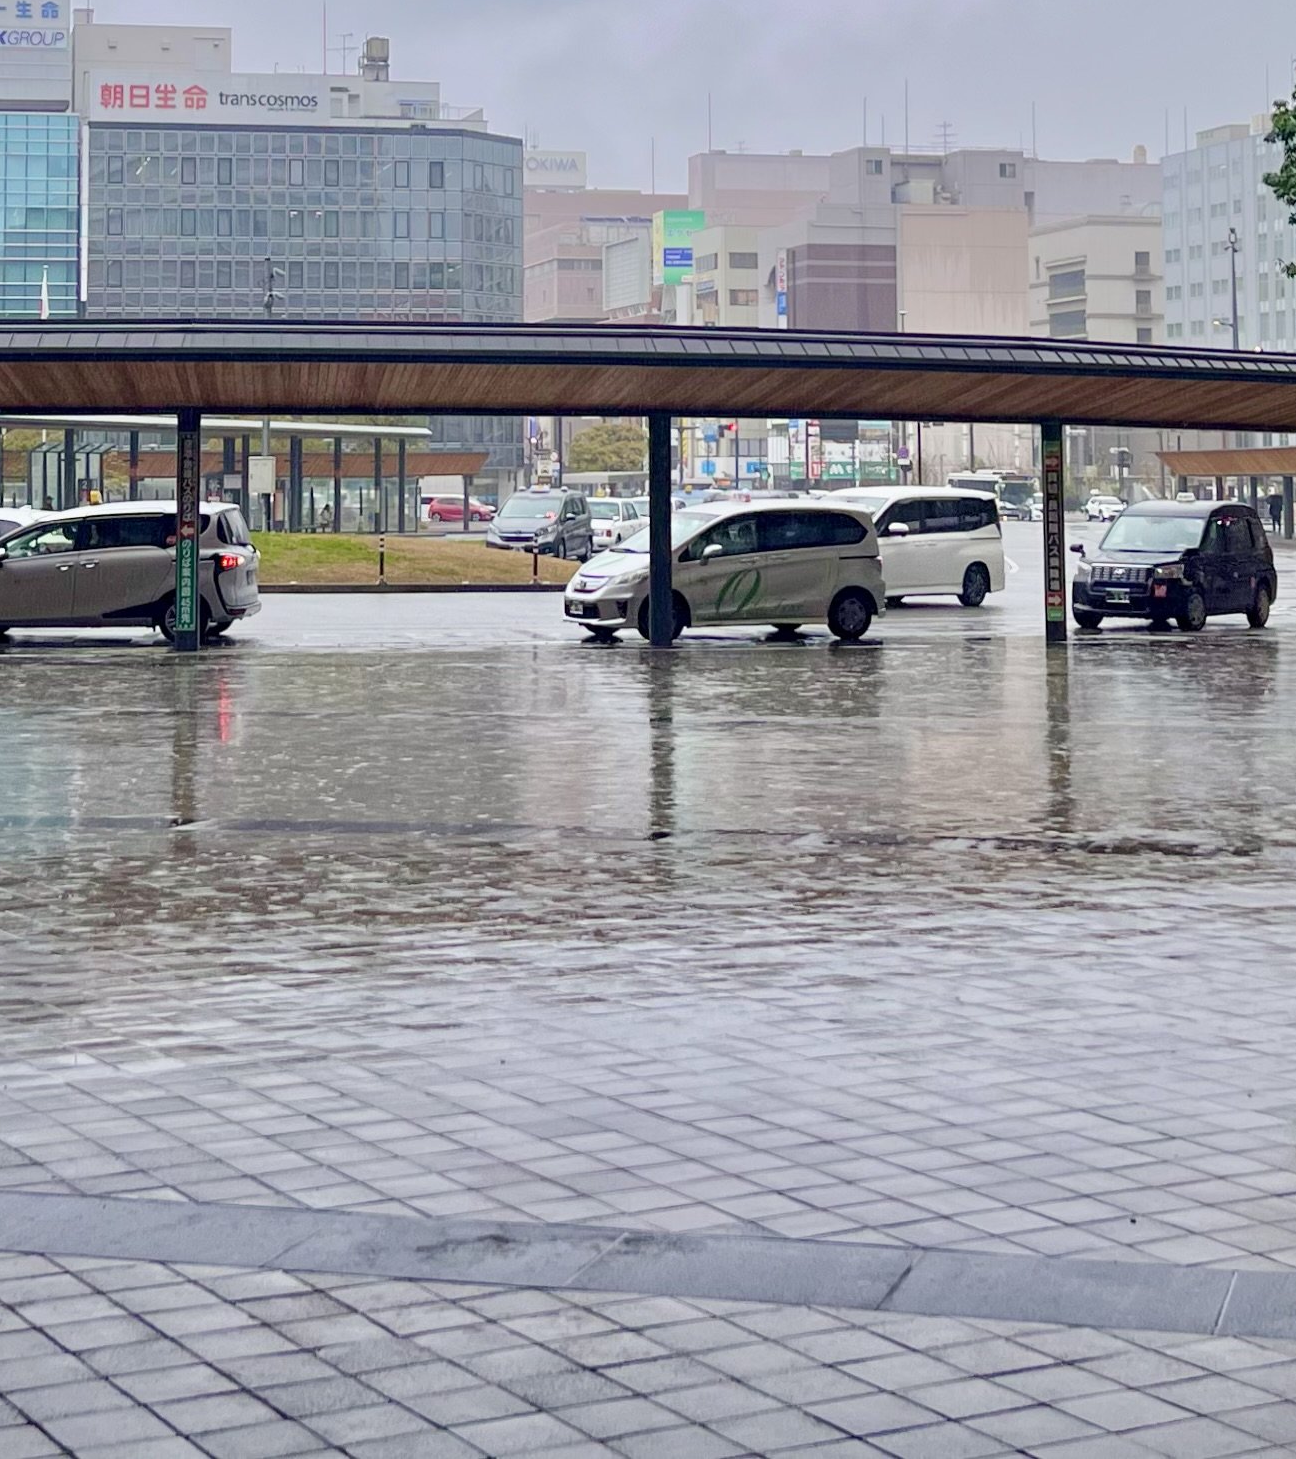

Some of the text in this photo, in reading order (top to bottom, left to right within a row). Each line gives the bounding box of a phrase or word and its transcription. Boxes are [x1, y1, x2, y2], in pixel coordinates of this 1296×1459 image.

[99, 82, 208, 110] 朝日生命
[219, 90, 319, 108] transcosmos
[523, 156, 579, 171] OKIWA
